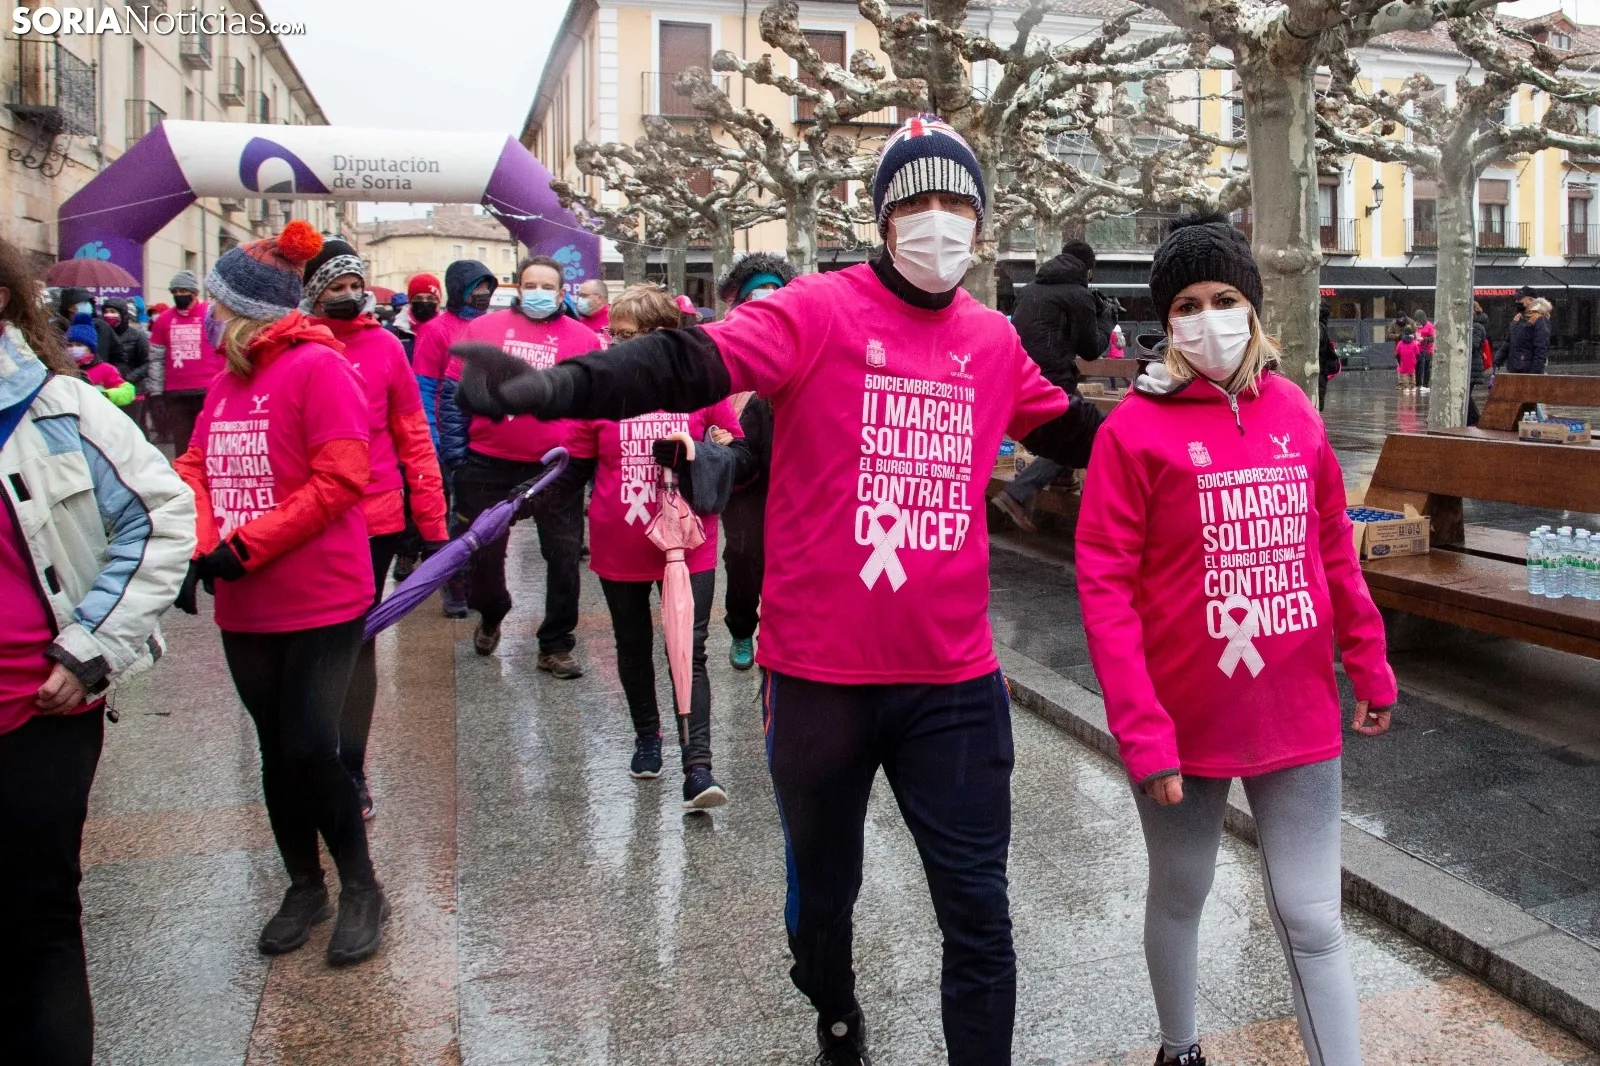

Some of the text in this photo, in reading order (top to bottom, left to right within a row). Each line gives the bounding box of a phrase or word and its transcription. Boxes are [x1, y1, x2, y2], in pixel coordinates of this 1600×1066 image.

[333, 154, 440, 176] Diputación
[333, 173, 412, 190] de Soria
[511, 347, 556, 365] MARCHA
[862, 391, 974, 436] II MARCHA
[620, 421, 690, 440] II MARCHA
[860, 425, 973, 466] SOLIDARIA
[621, 465, 662, 481] CONTR
[859, 456, 873, 472] EL
[875, 458, 913, 476] BURGO
[915, 461, 929, 476] DE
[930, 463, 956, 480] OSMA
[255, 487, 276, 509] EL
[857, 472, 943, 509] CONTRA
[948, 481, 972, 511] EL
[1198, 481, 1309, 524] II MARCHA
[1202, 514, 1307, 553] SOLIDARIA
[1204, 555, 1219, 569] EL
[1220, 551, 1256, 569] BURGO
[1258, 549, 1272, 565] DE
[1272, 546, 1296, 562] OSMA
[1204, 559, 1309, 597] CONTRA EL
